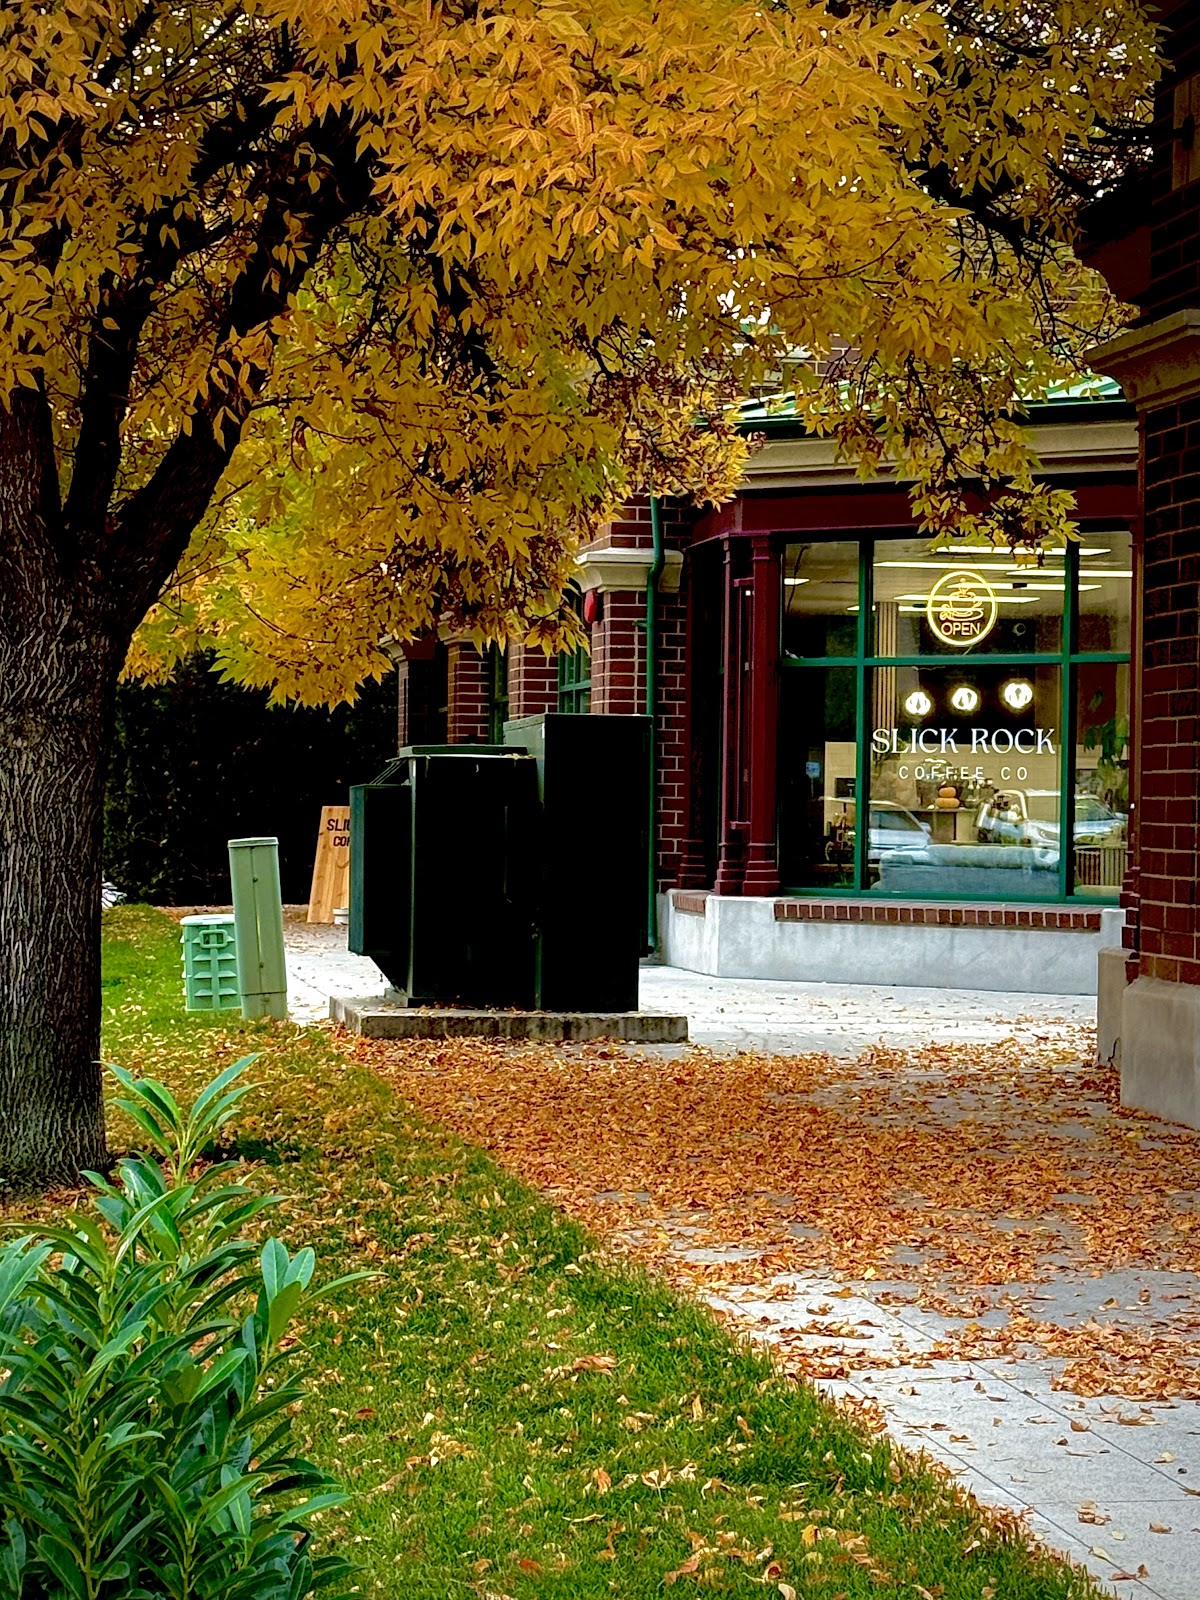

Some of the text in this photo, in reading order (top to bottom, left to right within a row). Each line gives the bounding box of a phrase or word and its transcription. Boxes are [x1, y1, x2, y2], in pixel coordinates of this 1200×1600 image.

[941, 622, 980, 635] OPEN
[872, 728, 1056, 755] SLICK ROCK
[899, 766, 1028, 780] COFFEE CO
